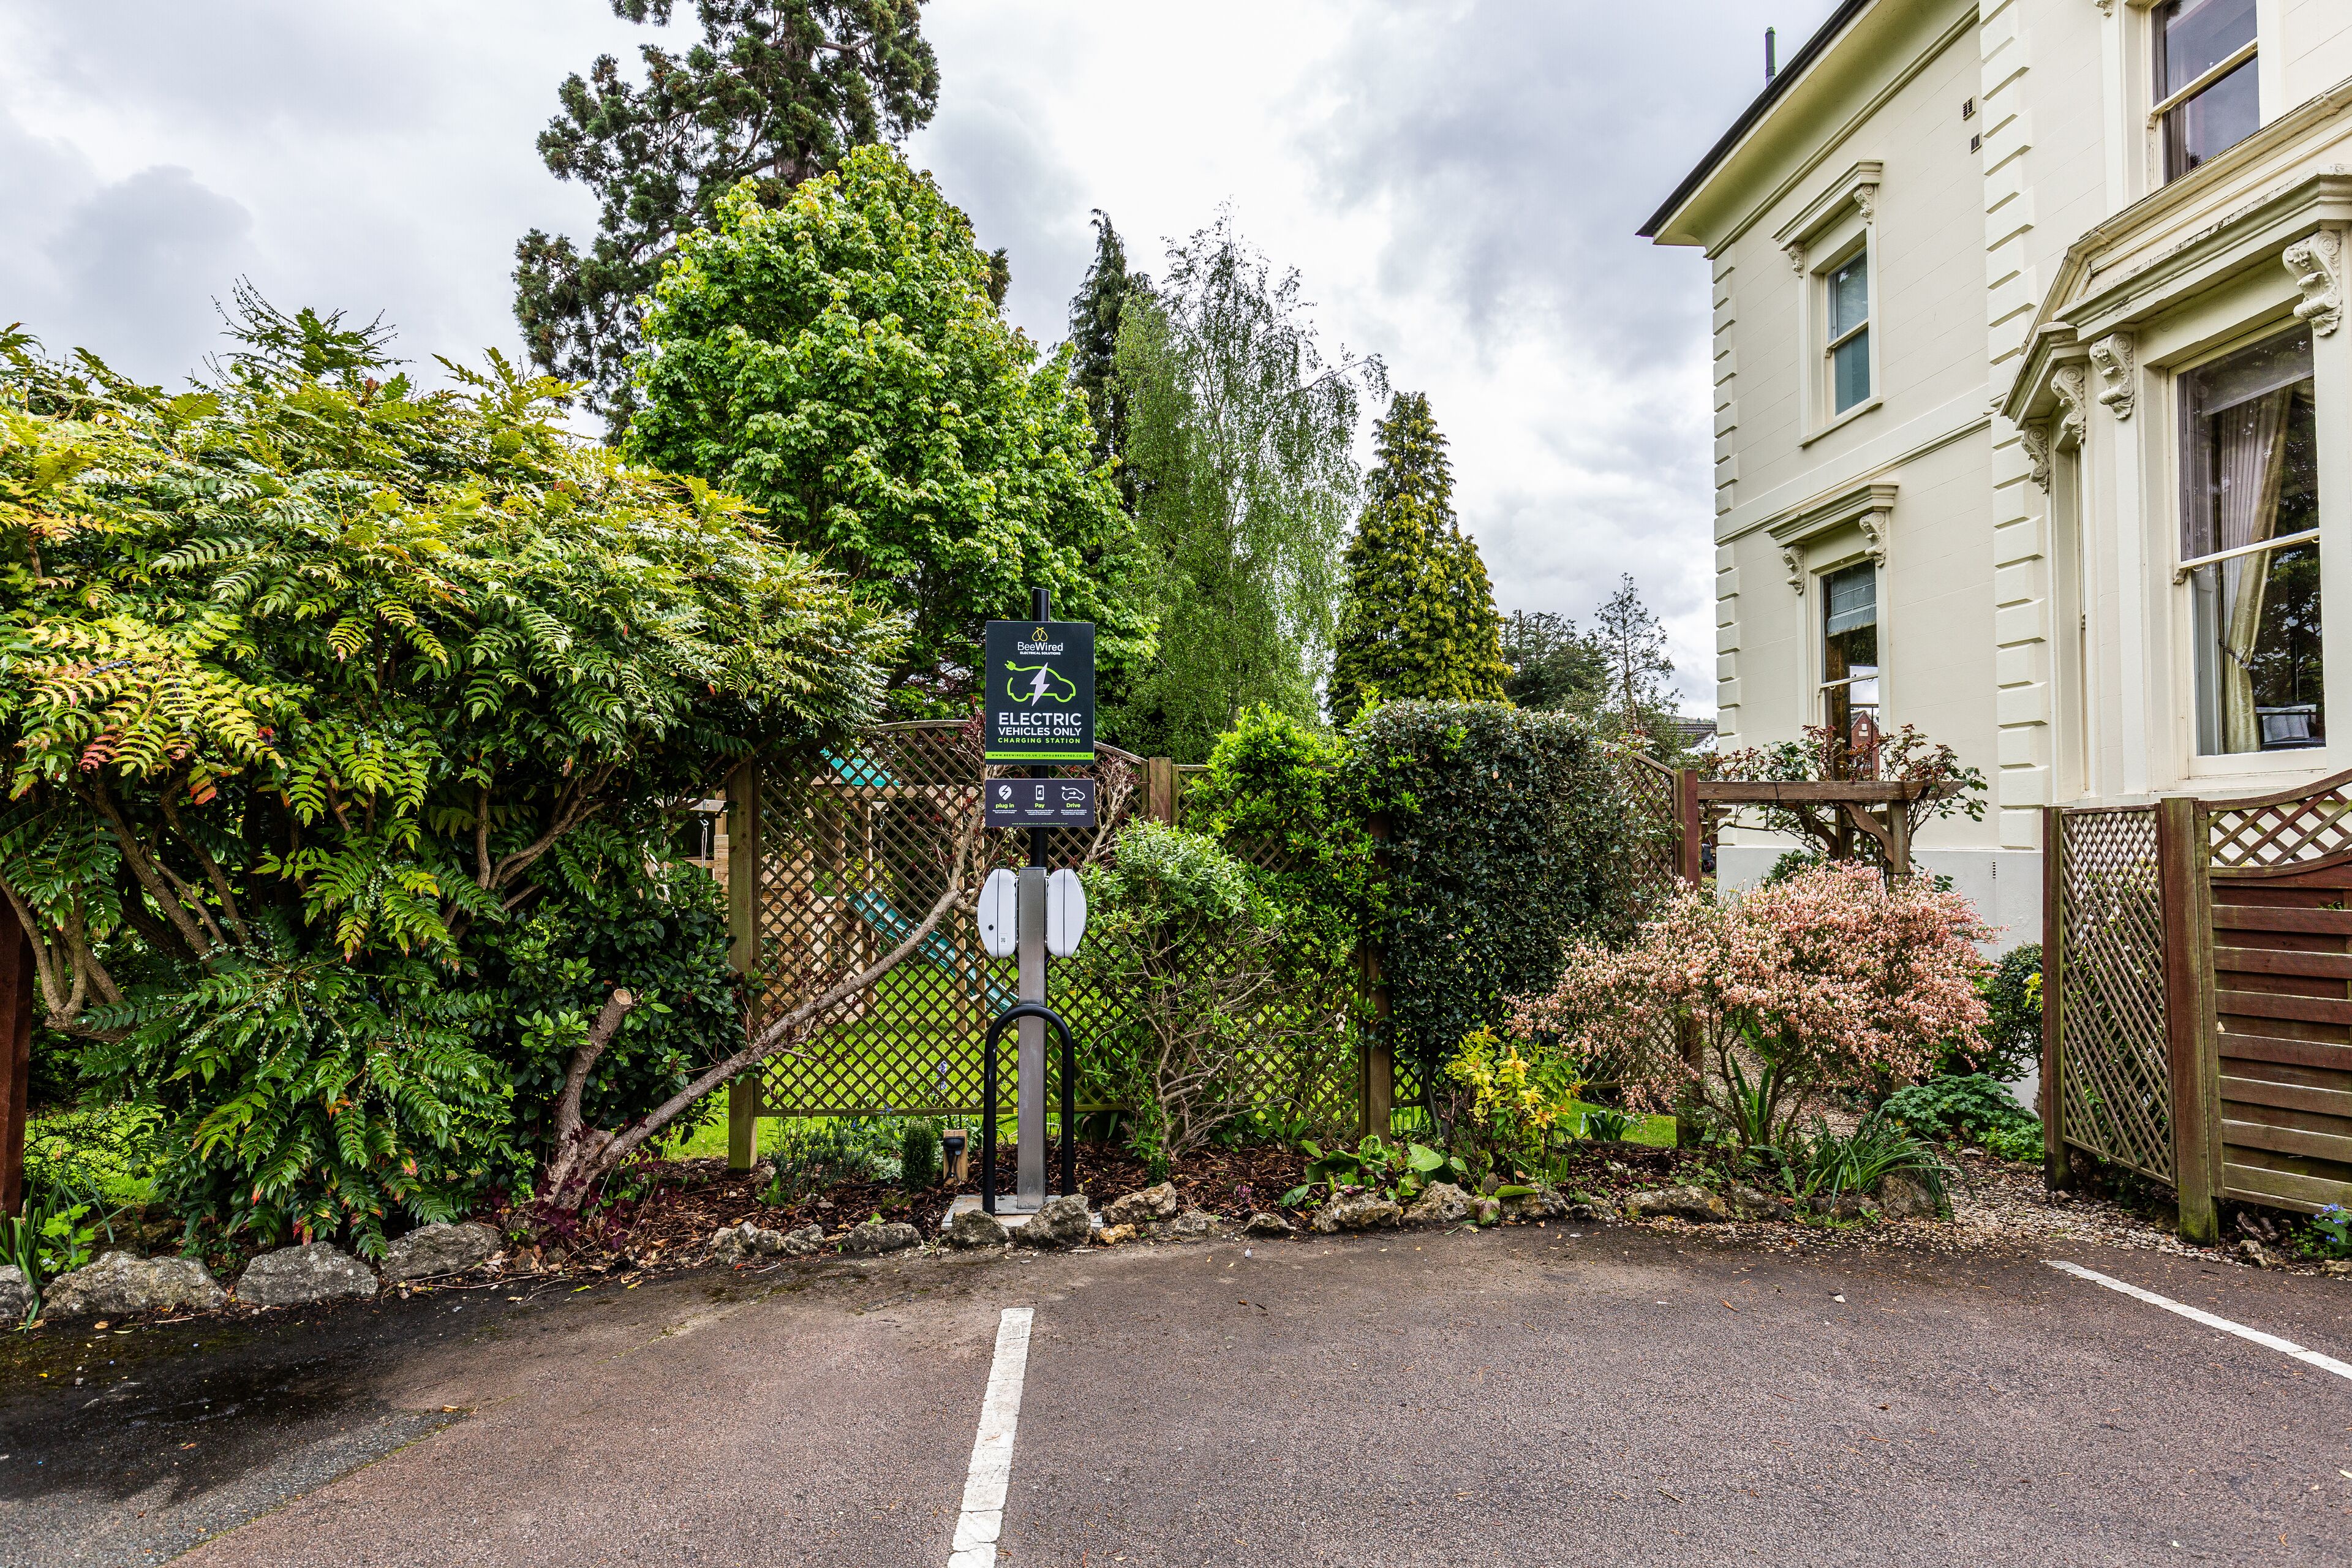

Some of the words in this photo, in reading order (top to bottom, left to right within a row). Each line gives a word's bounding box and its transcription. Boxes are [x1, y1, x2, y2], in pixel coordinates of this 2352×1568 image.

[1017, 641, 1063, 651] BeeWired
[998, 712, 1082, 726] ELECTRIC
[998, 727, 1050, 736] VEHICLES
[1053, 727, 1082, 736] ONLY
